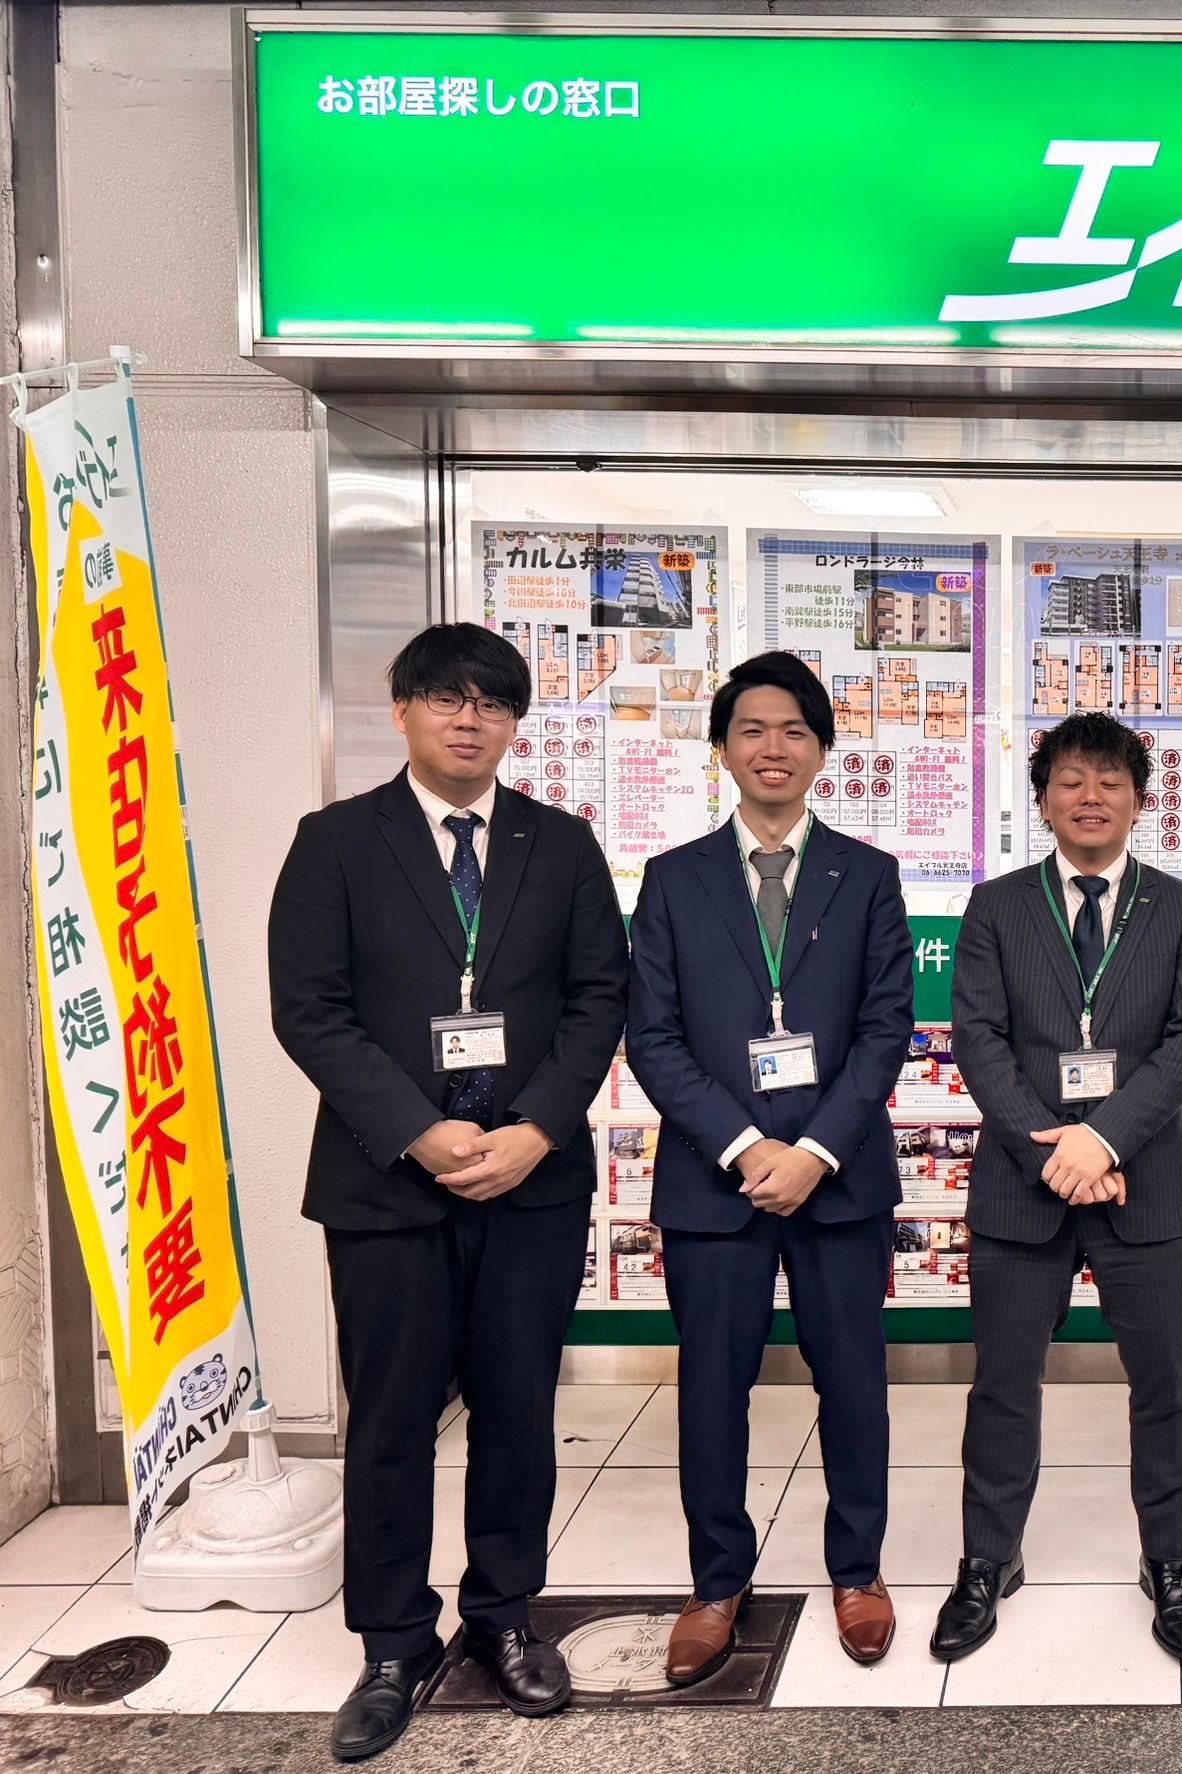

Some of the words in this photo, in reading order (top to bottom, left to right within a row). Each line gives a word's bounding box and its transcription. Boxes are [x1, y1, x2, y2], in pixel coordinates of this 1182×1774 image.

[316, 75, 642, 119] お部屋探しの窓口
[506, 546, 627, 571] カルム共栄
[662, 553, 691, 568] 新築
[940, 575, 967, 590] 新築
[507, 598, 586, 610] 北田辺駅徒歩10分
[785, 618, 854, 629] 平野駅徒歩16分
[907, 746, 960, 754] インターネット
[907, 800, 968, 809] システムキッチン
[907, 809, 953, 817] オートロック
[915, 937, 950, 973] 件
